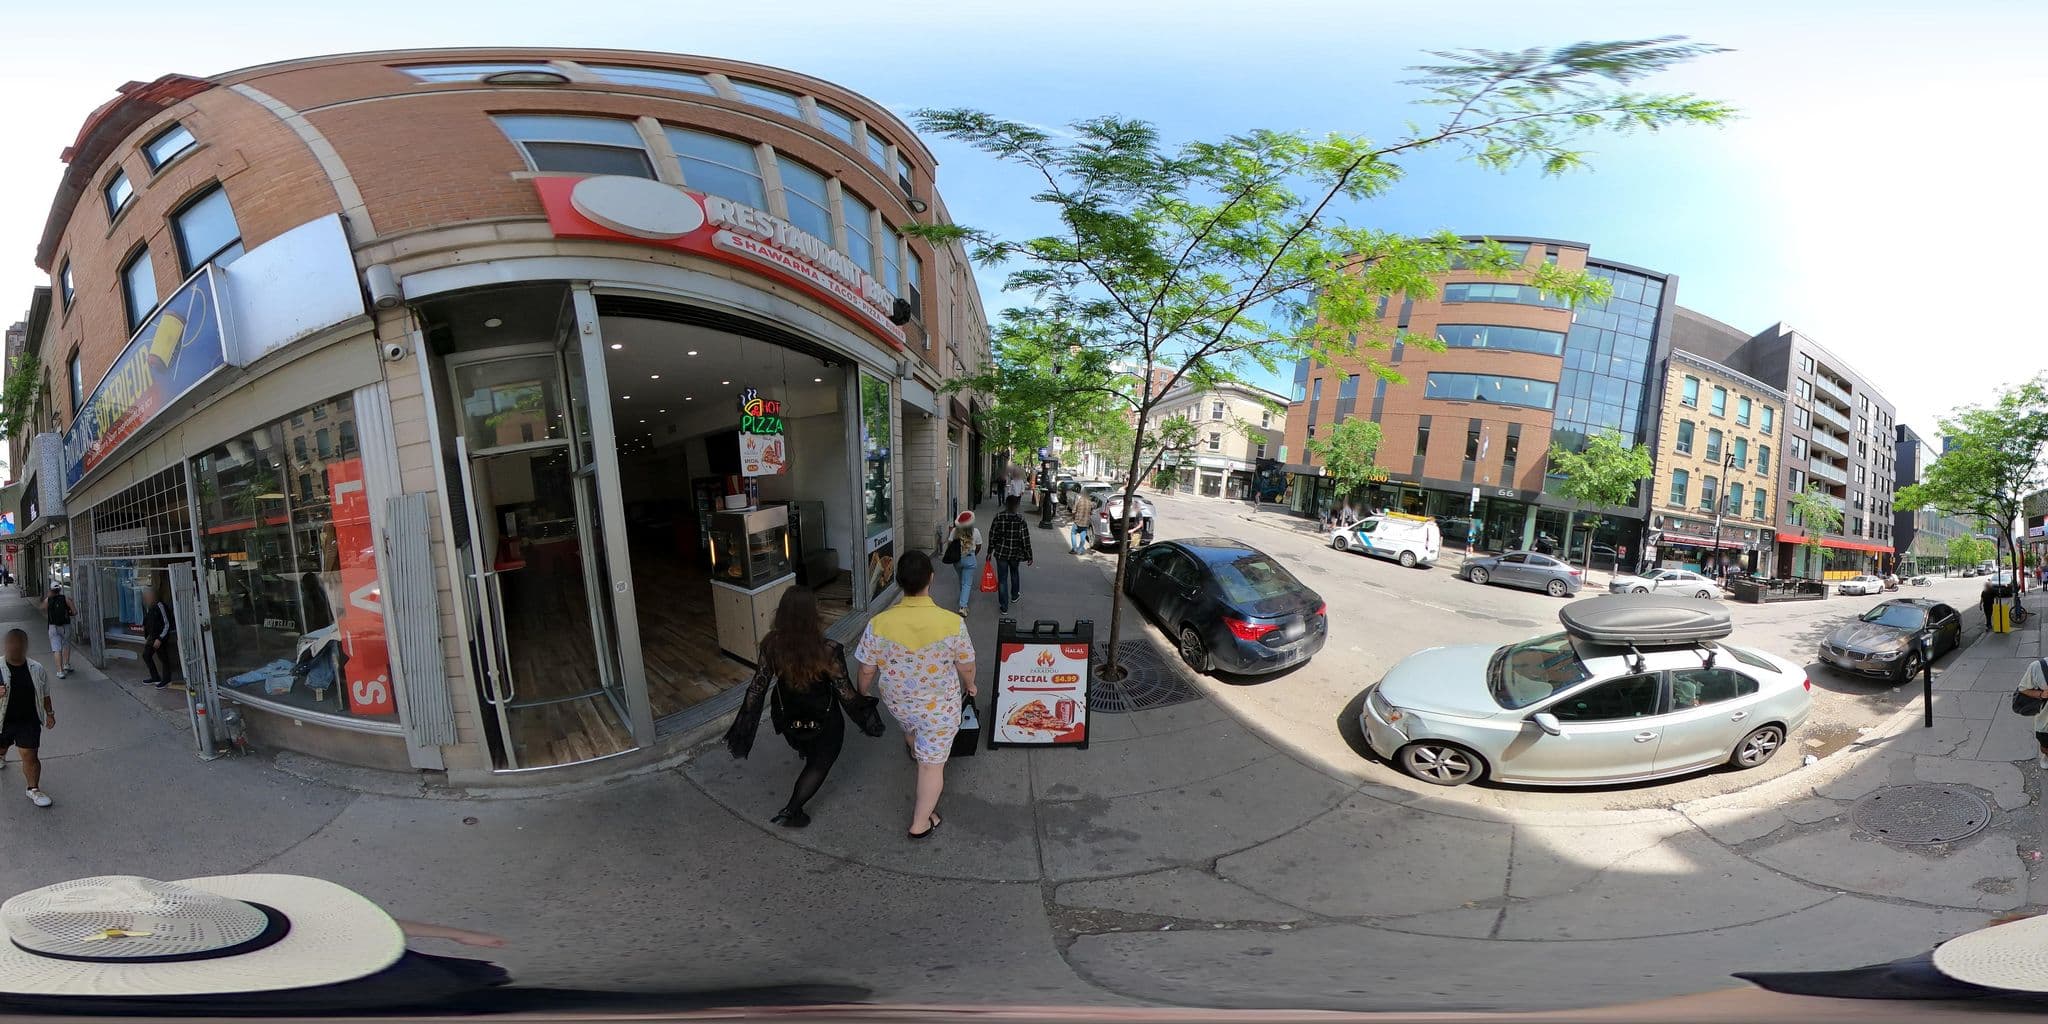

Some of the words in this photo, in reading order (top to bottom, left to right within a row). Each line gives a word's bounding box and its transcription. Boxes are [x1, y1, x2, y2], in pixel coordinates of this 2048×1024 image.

[705, 196, 862, 291] RESTAURANT
[731, 235, 820, 281] SHAWARMA
[828, 279, 859, 309] TACOS
[862, 301, 881, 322] PIZZA
[763, 401, 782, 414] HOT
[742, 415, 784, 433] PIZZA
[1498, 488, 1514, 497] 66
[873, 535, 888, 547] Tacos
[1007, 674, 1048, 683] SPECIAL
[1055, 675, 1077, 683] $4.99
